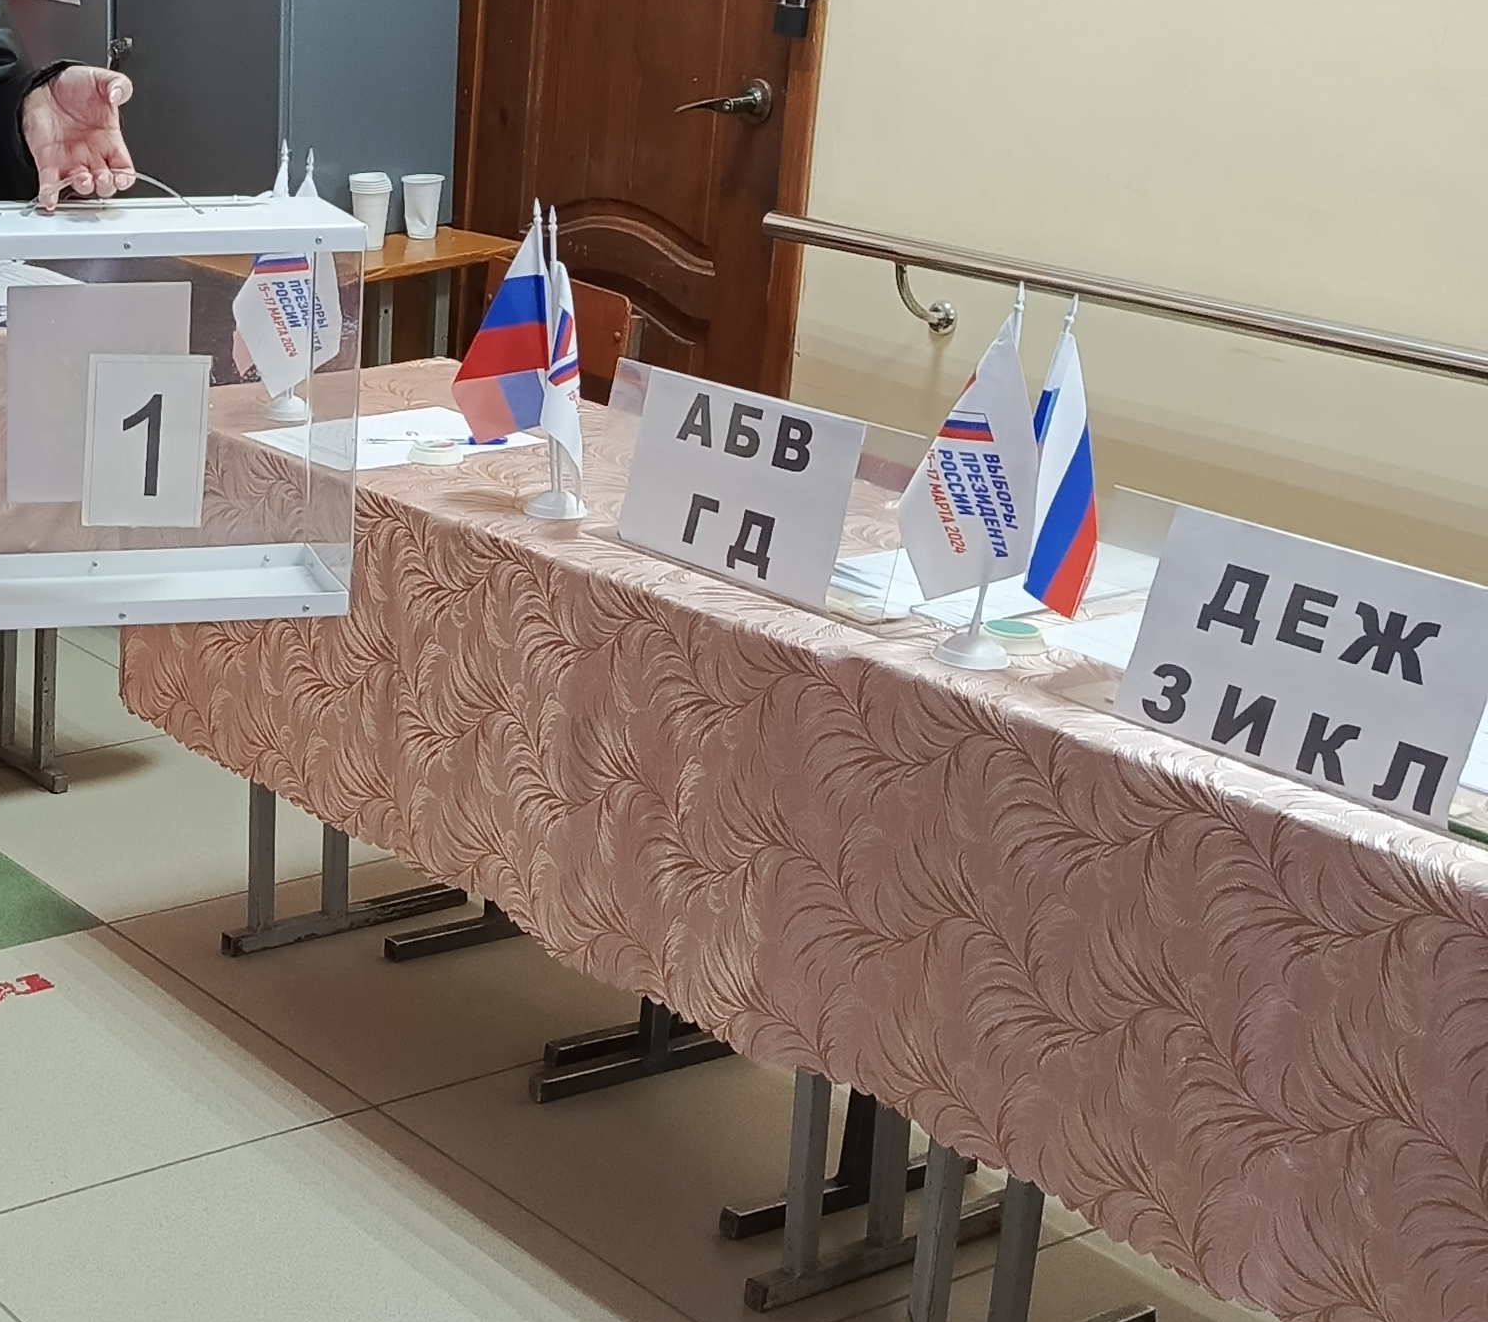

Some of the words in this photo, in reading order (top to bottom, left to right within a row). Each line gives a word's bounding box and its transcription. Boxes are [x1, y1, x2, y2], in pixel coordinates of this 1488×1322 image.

[267, 306, 289, 337] МАРТА
[271, 281, 303, 329] РОССИИ
[122, 393, 164, 497] 1
[928, 482, 956, 523] МАРТА
[943, 524, 968, 554] 2024
[938, 448, 975, 516] РОССИИ
[958, 451, 1009, 558] ПРЕЗИДЕНТА
[982, 452, 1019, 530] ВЫБОРЫ
